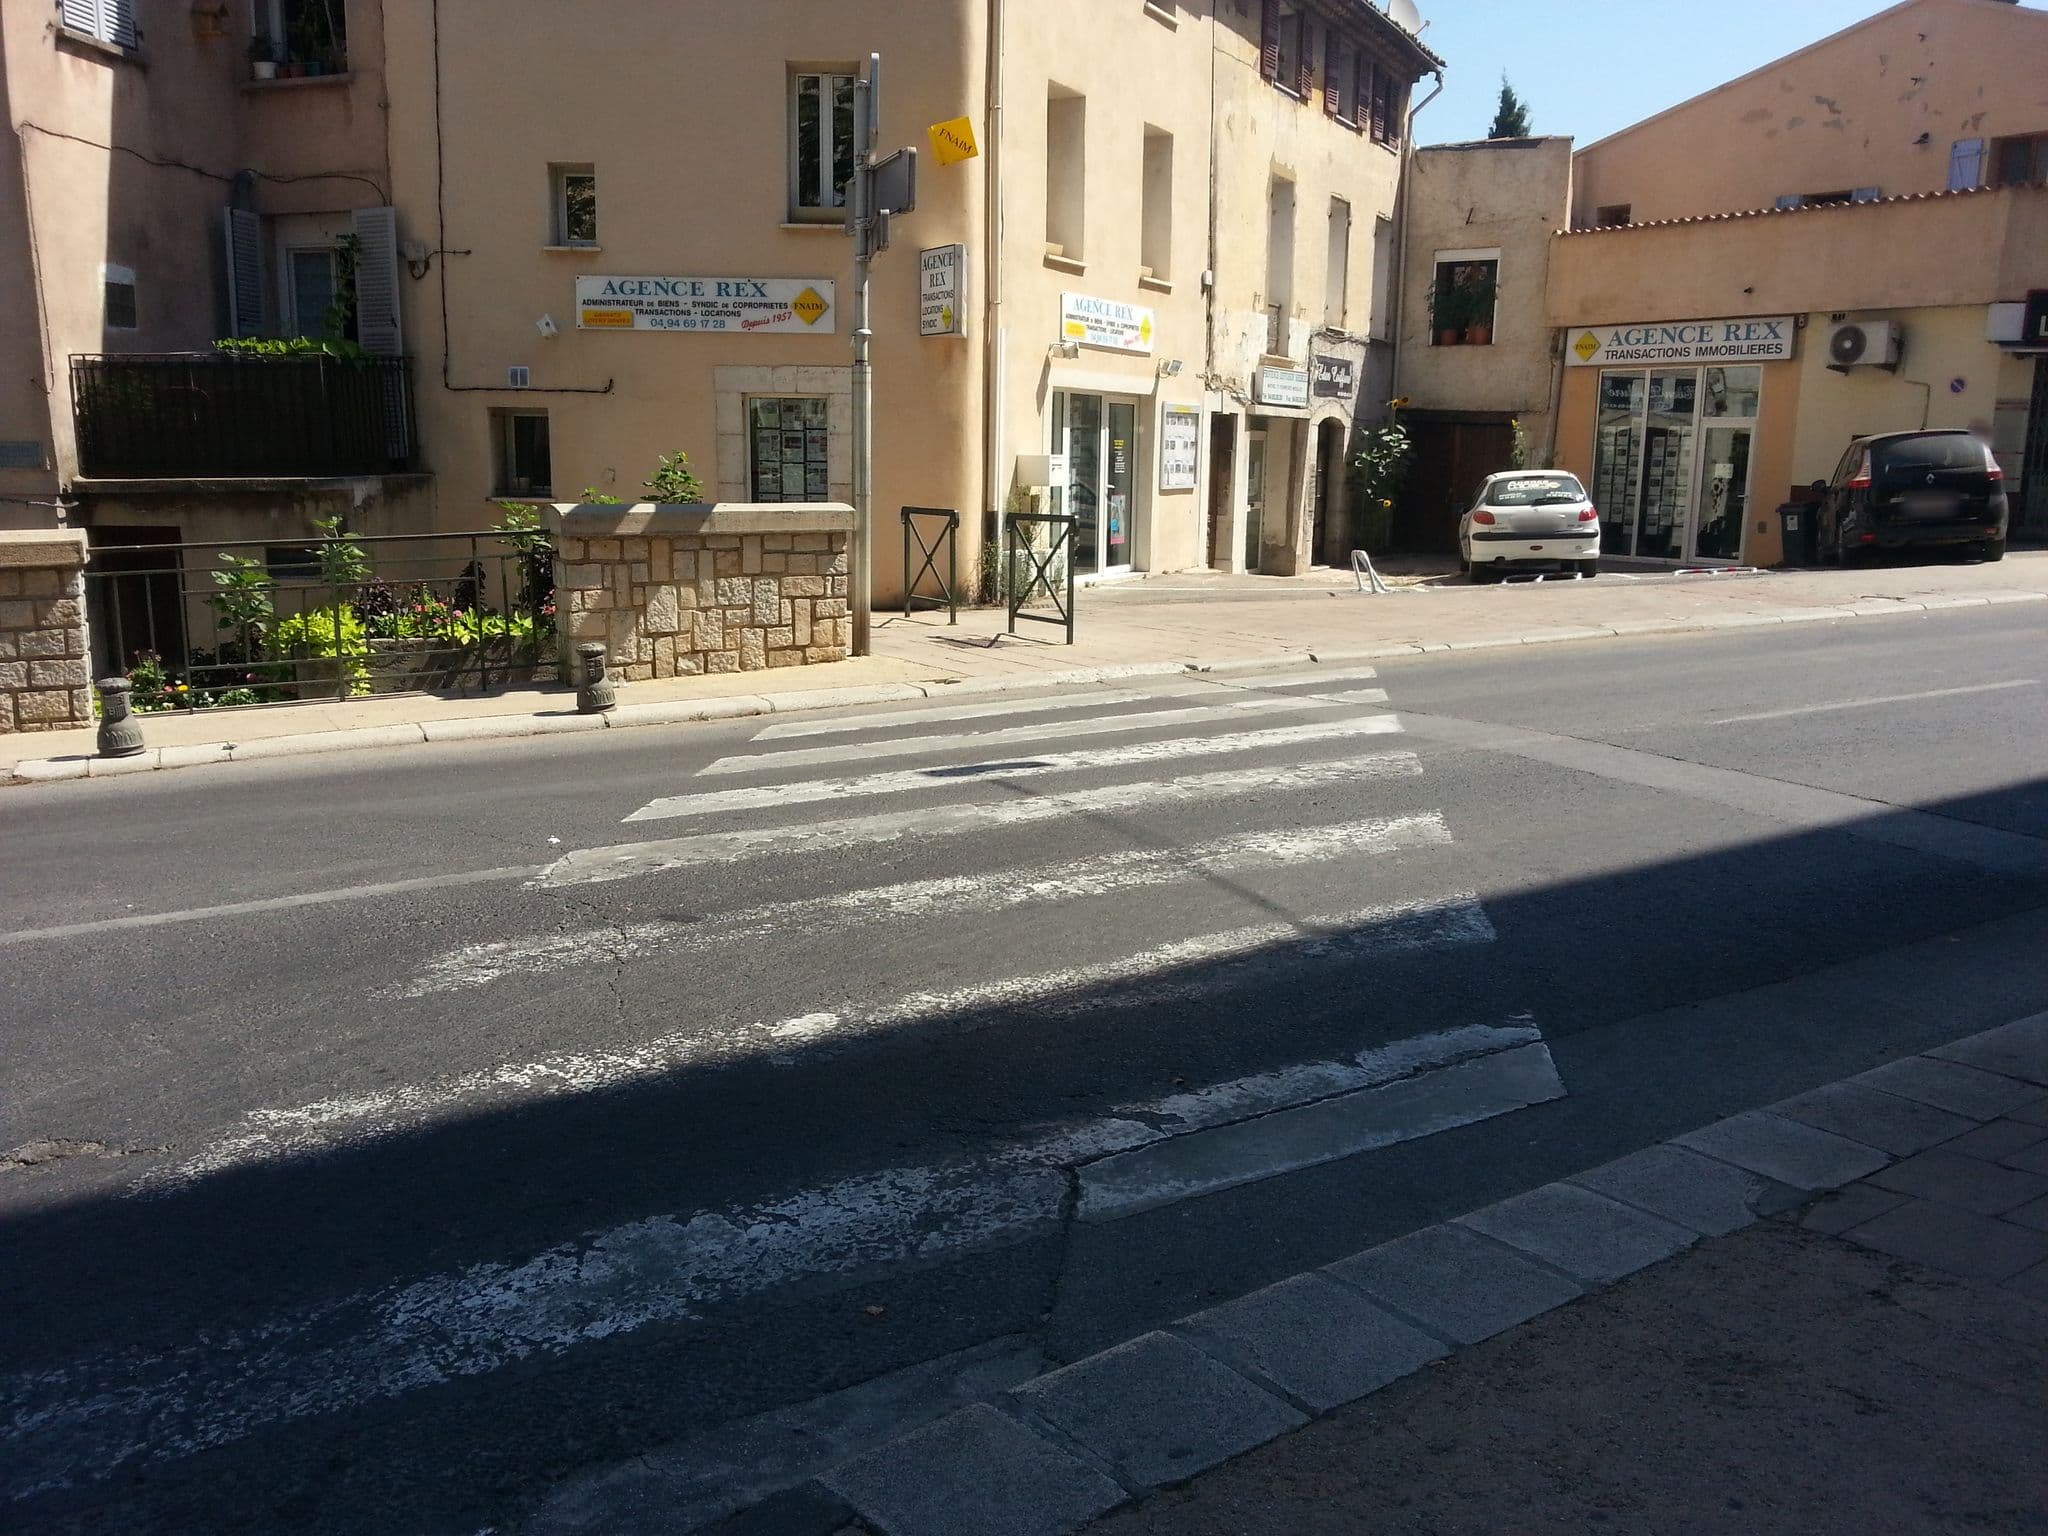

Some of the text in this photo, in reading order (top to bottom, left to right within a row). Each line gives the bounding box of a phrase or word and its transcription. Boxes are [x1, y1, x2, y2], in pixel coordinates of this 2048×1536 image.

[939, 128, 973, 153] FNAIM
[922, 252, 954, 272] AGENCE
[929, 271, 946, 288] REX
[602, 280, 768, 298] AGENCE REX
[922, 290, 954, 303] TRANSACTIONS
[582, 299, 643, 307] ADMINISTRATEUR
[691, 301, 718, 309] SYNDIC
[732, 302, 788, 310] COPROPRIETES
[794, 303, 823, 311] FNAIM
[1073, 297, 1133, 321] AGENCE REX
[701, 310, 741, 318] LOCATIONS
[741, 311, 792, 329] Depuis 1957
[650, 318, 726, 329] 04 94 69 17 28
[1608, 320, 1784, 347] AGENCE REX
[1574, 342, 1597, 351] FNAIM
[1605, 342, 1784, 361] TRANSACTIONS IMMOBILIERES
